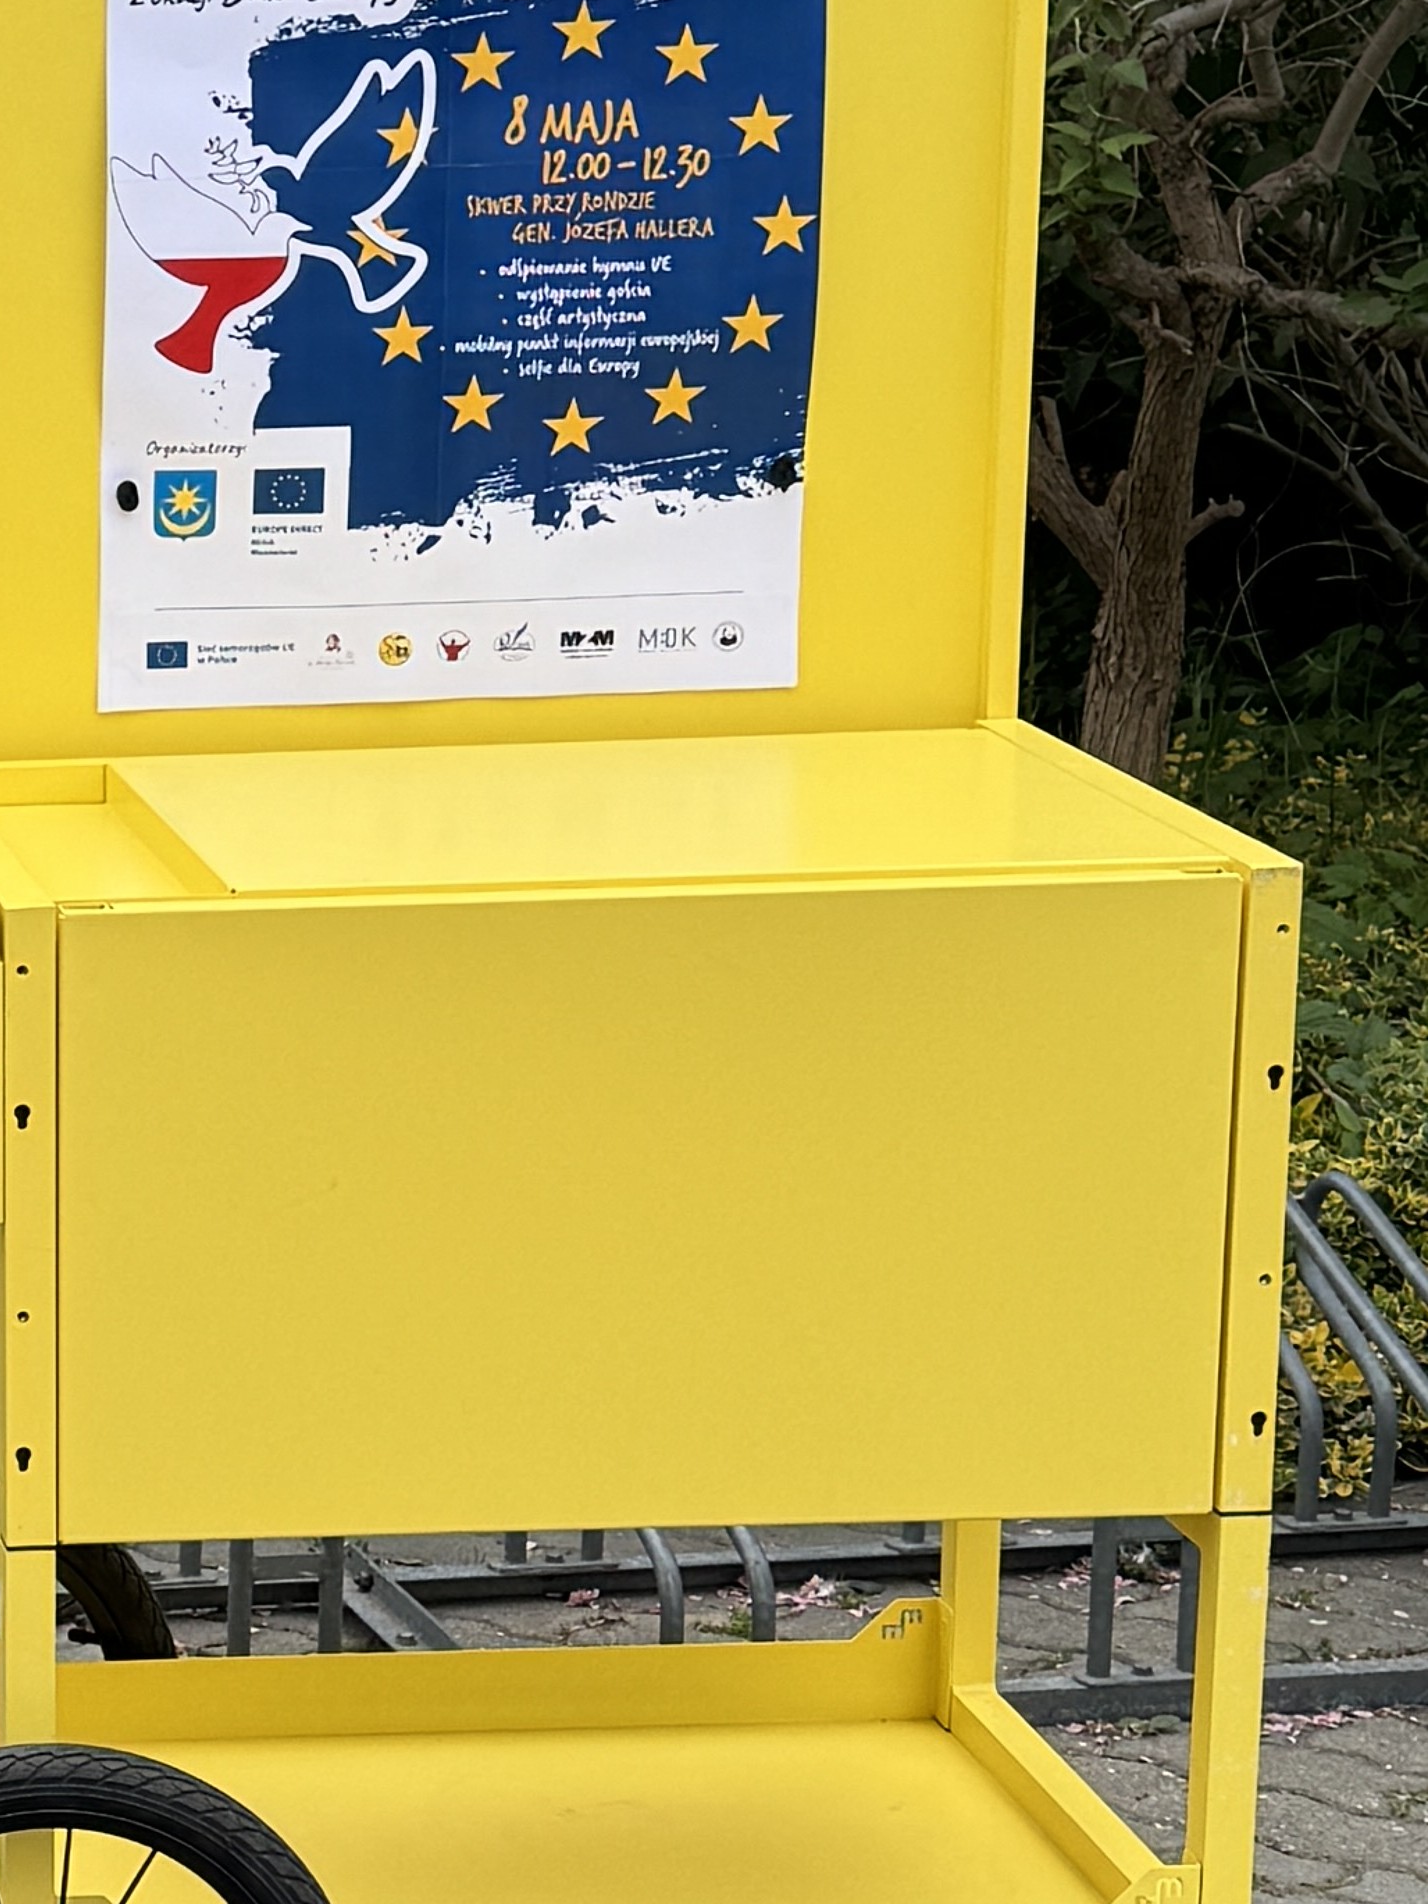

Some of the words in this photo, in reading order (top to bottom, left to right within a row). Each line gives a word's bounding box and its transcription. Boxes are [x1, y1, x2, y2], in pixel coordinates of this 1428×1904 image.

[504, 94, 529, 145] 8
[540, 98, 640, 145] MAJA
[466, 194, 527, 218] SKWER
[532, 192, 575, 215] PRZY
[581, 191, 656, 213] RONDZIE
[512, 222, 556, 244] GEN.
[562, 212, 629, 243] JÓZEFA
[635, 217, 714, 239] HALLERA
[651, 255, 672, 272] UE
[607, 278, 652, 305] gościa
[557, 305, 647, 331] artystyczna
[557, 357, 582, 374] dla
[589, 357, 640, 379] Europy
